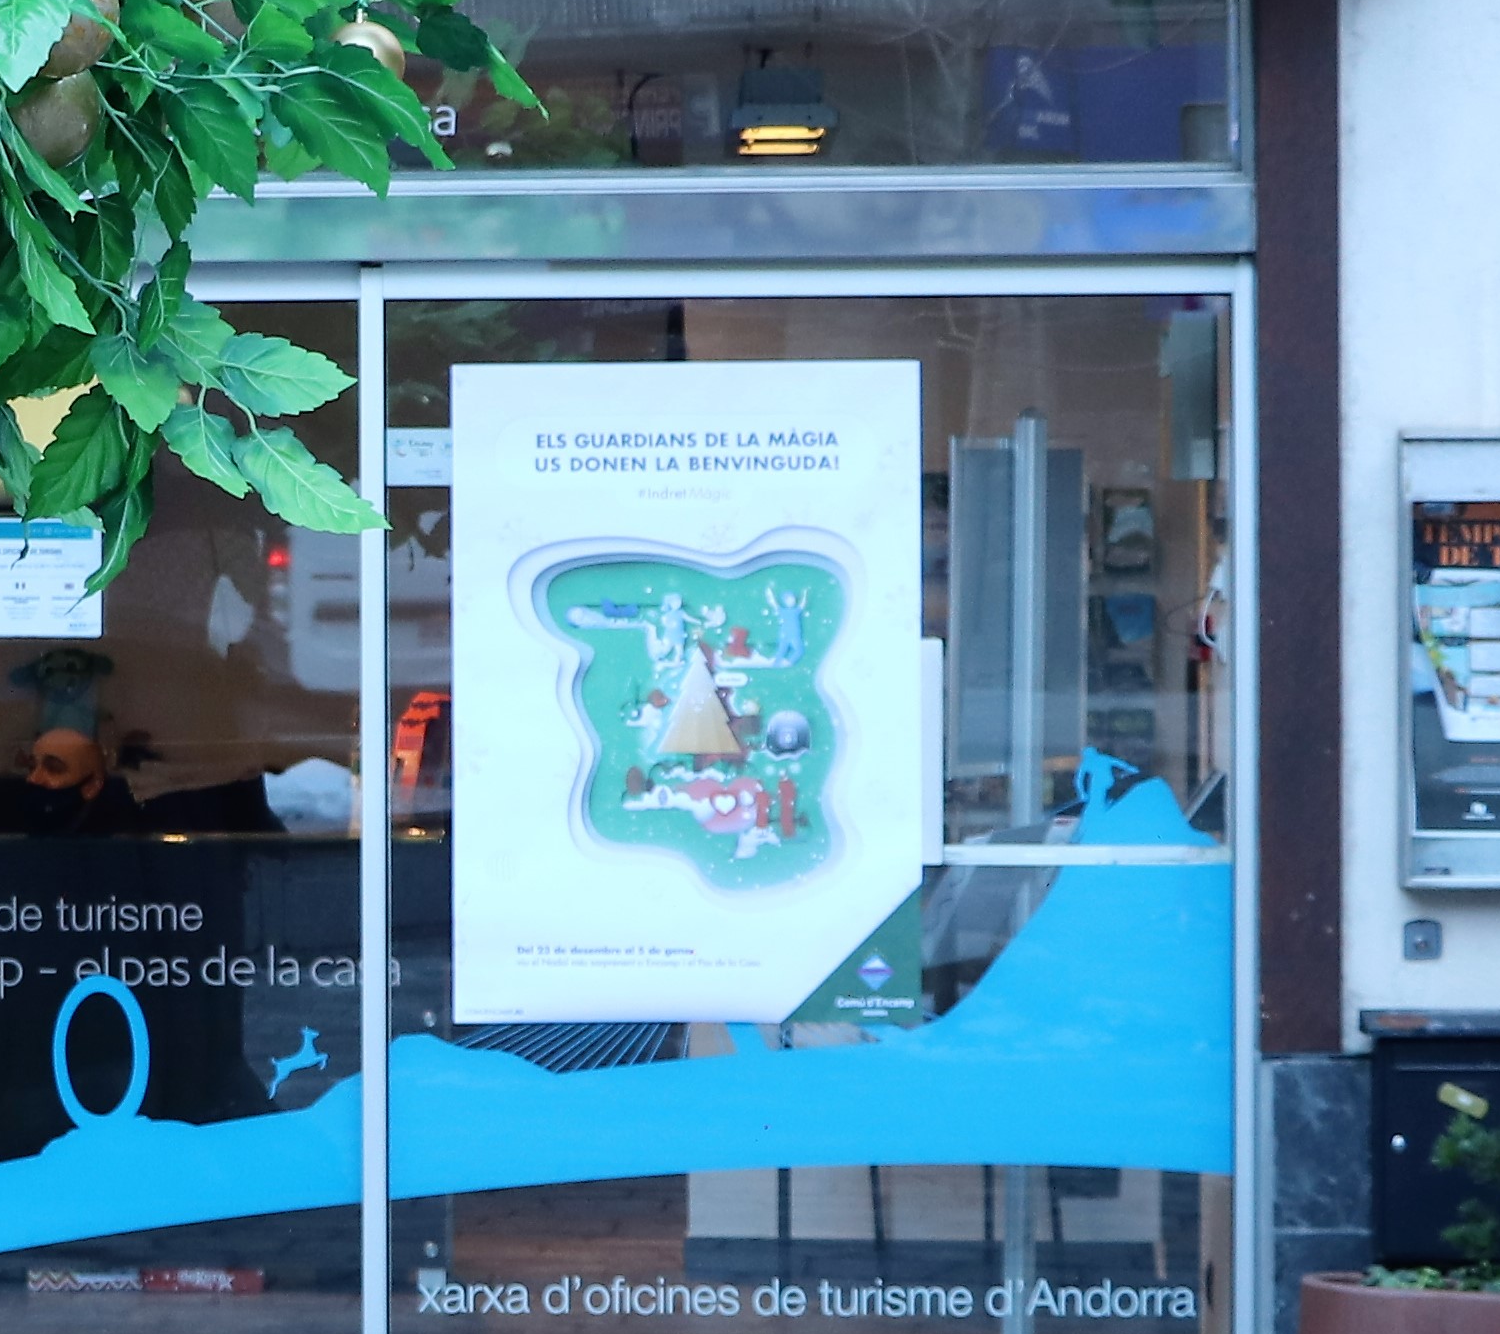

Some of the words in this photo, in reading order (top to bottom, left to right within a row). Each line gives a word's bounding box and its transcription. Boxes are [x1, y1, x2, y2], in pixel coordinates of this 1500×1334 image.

[536, 430, 567, 448] ELS
[574, 430, 697, 448] GUARDIANS
[704, 430, 729, 447] DE
[736, 430, 760, 447] LA
[768, 427, 839, 447] MÀGIA
[535, 455, 561, 472] US
[570, 455, 647, 472] DONEN
[655, 455, 680, 471] LA
[688, 454, 839, 471] BENVINGUDA!
[1439, 544, 1480, 567] DE
[56, 895, 204, 932] turisme
[202, 944, 256, 987] de
[267, 944, 300, 987] la
[418, 1283, 531, 1315] xarxa
[542, 1274, 741, 1316] d'oficines
[752, 1276, 807, 1317] de
[819, 1277, 974, 1317] turisme
[984, 1277, 1197, 1317] d'Andorra
